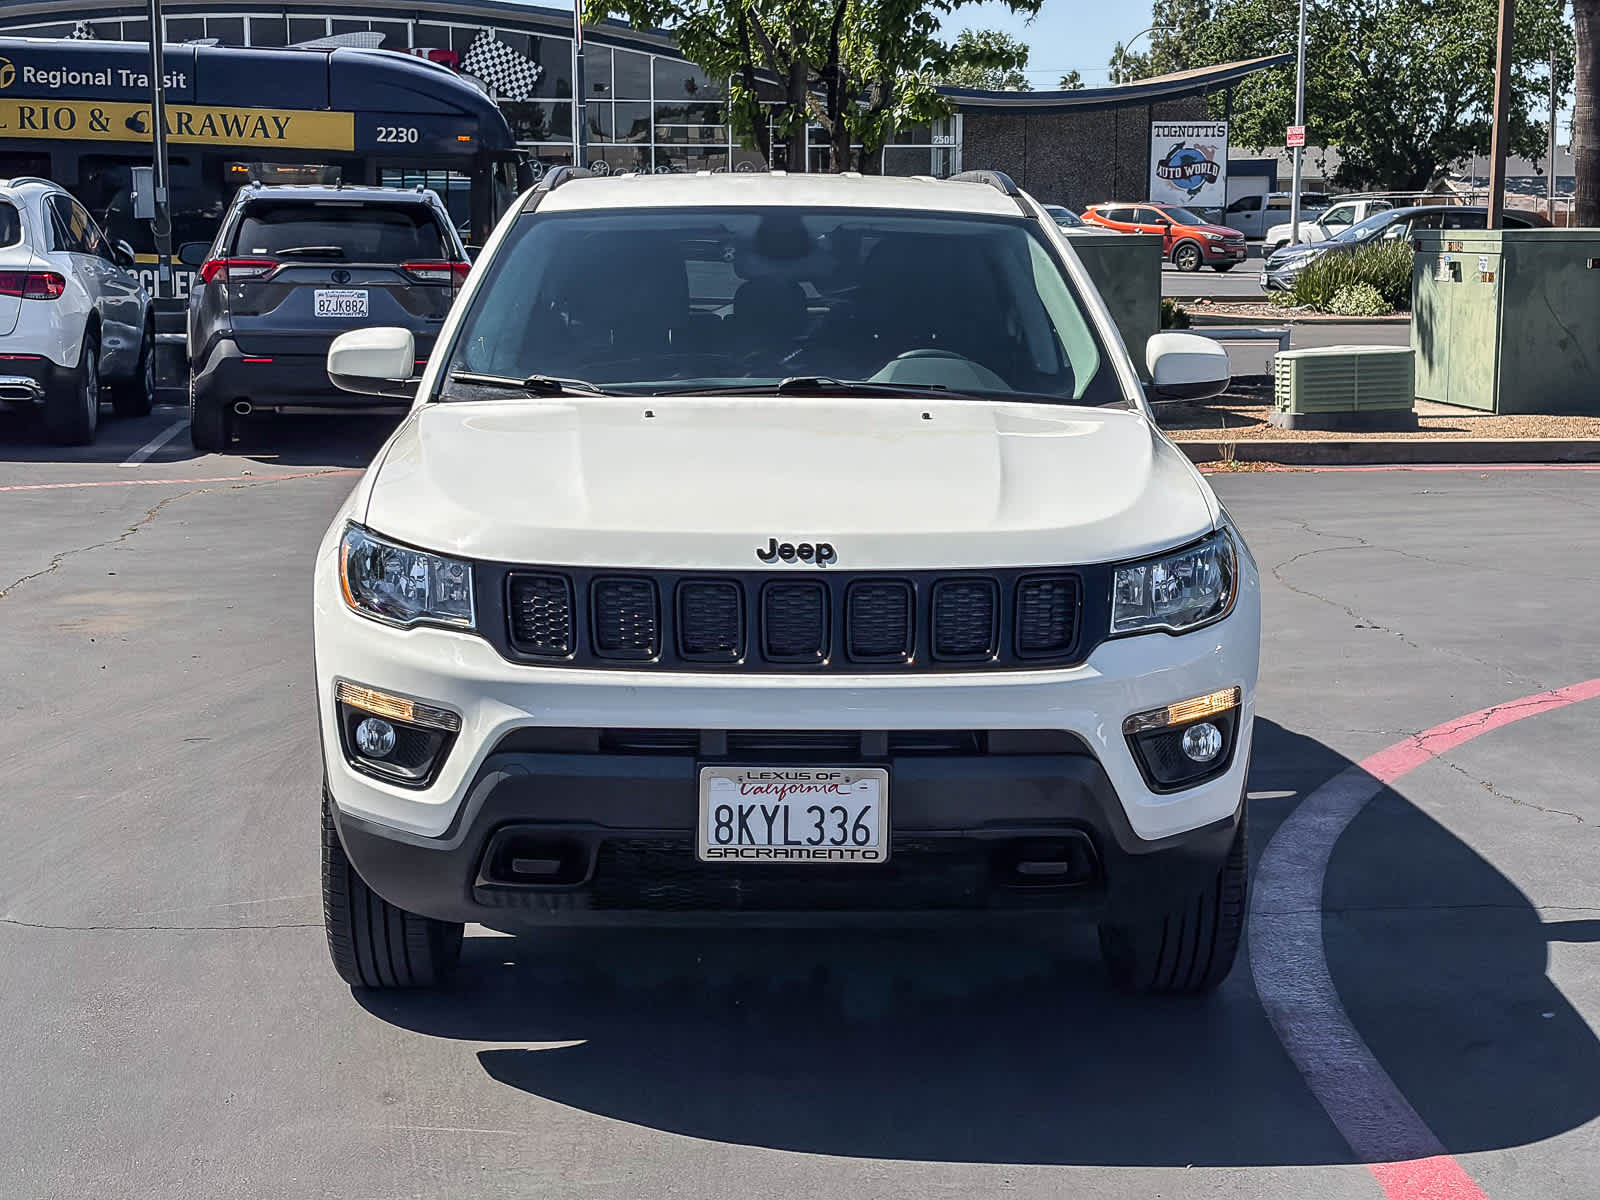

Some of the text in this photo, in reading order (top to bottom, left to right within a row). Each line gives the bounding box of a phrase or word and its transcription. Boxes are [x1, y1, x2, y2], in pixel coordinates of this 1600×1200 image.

[22, 66, 187, 89] Regional Trasit
[18, 105, 77, 132] RIO
[88, 107, 112, 133] &
[376, 126, 419, 144] 2230
[1154, 123, 1226, 138] TOGNOTTI'S
[1157, 162, 1218, 178] AUTO WORLD
[319, 299, 365, 312] 8ZJK882
[756, 537, 837, 568] Jeep
[747, 771, 841, 781] LEXUS OF
[740, 783, 851, 802] California
[714, 804, 872, 846] 8KYL336
[706, 847, 880, 860] SACRAMENTO
